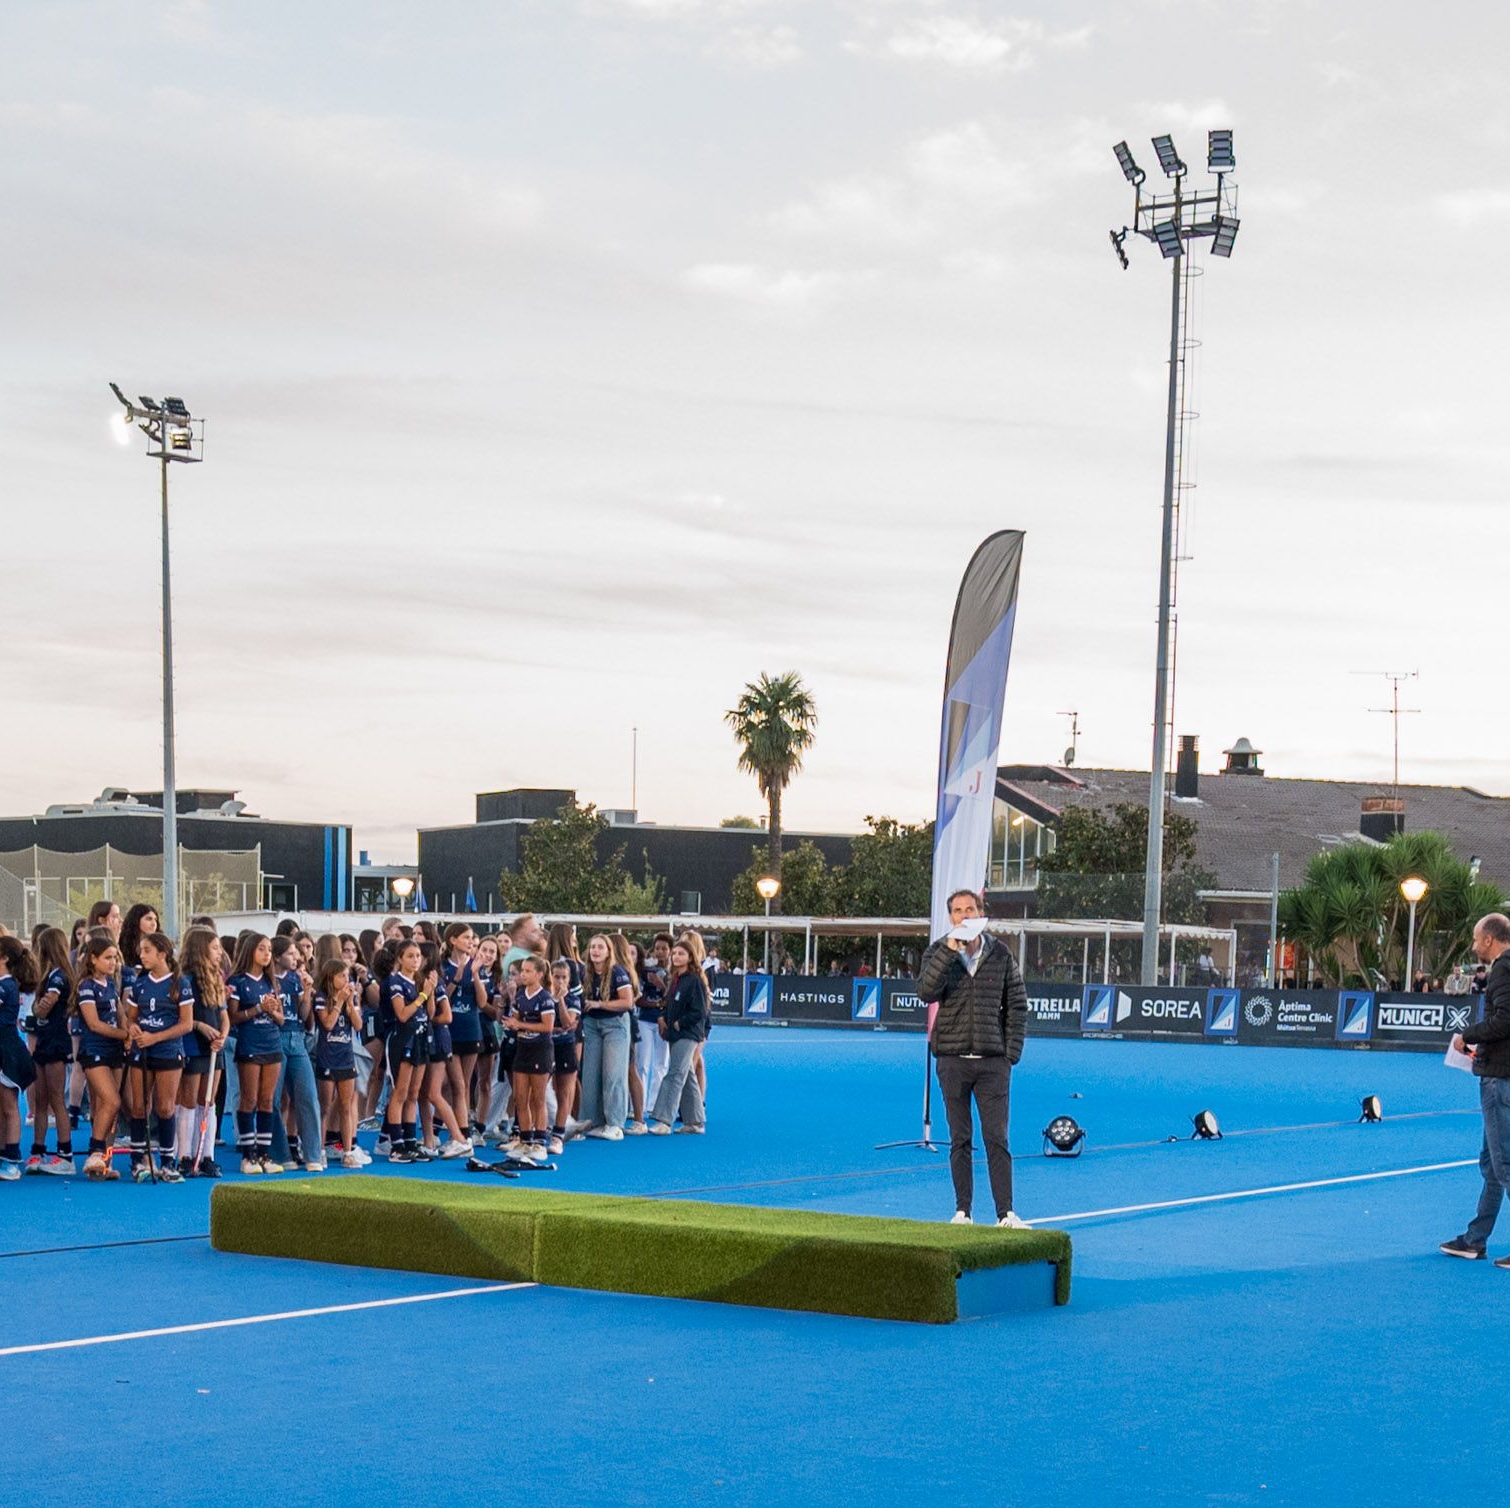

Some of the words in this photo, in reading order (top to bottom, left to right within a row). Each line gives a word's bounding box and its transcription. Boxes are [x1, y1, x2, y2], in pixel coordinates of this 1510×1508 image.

[780, 992, 845, 1004] HASTINGS
[1141, 1000, 1202, 1019] SOREA
[1037, 1012, 1060, 1021] DAMM
[1278, 1012, 1309, 1023] Centre
[1381, 1008, 1442, 1026] MUNICH
